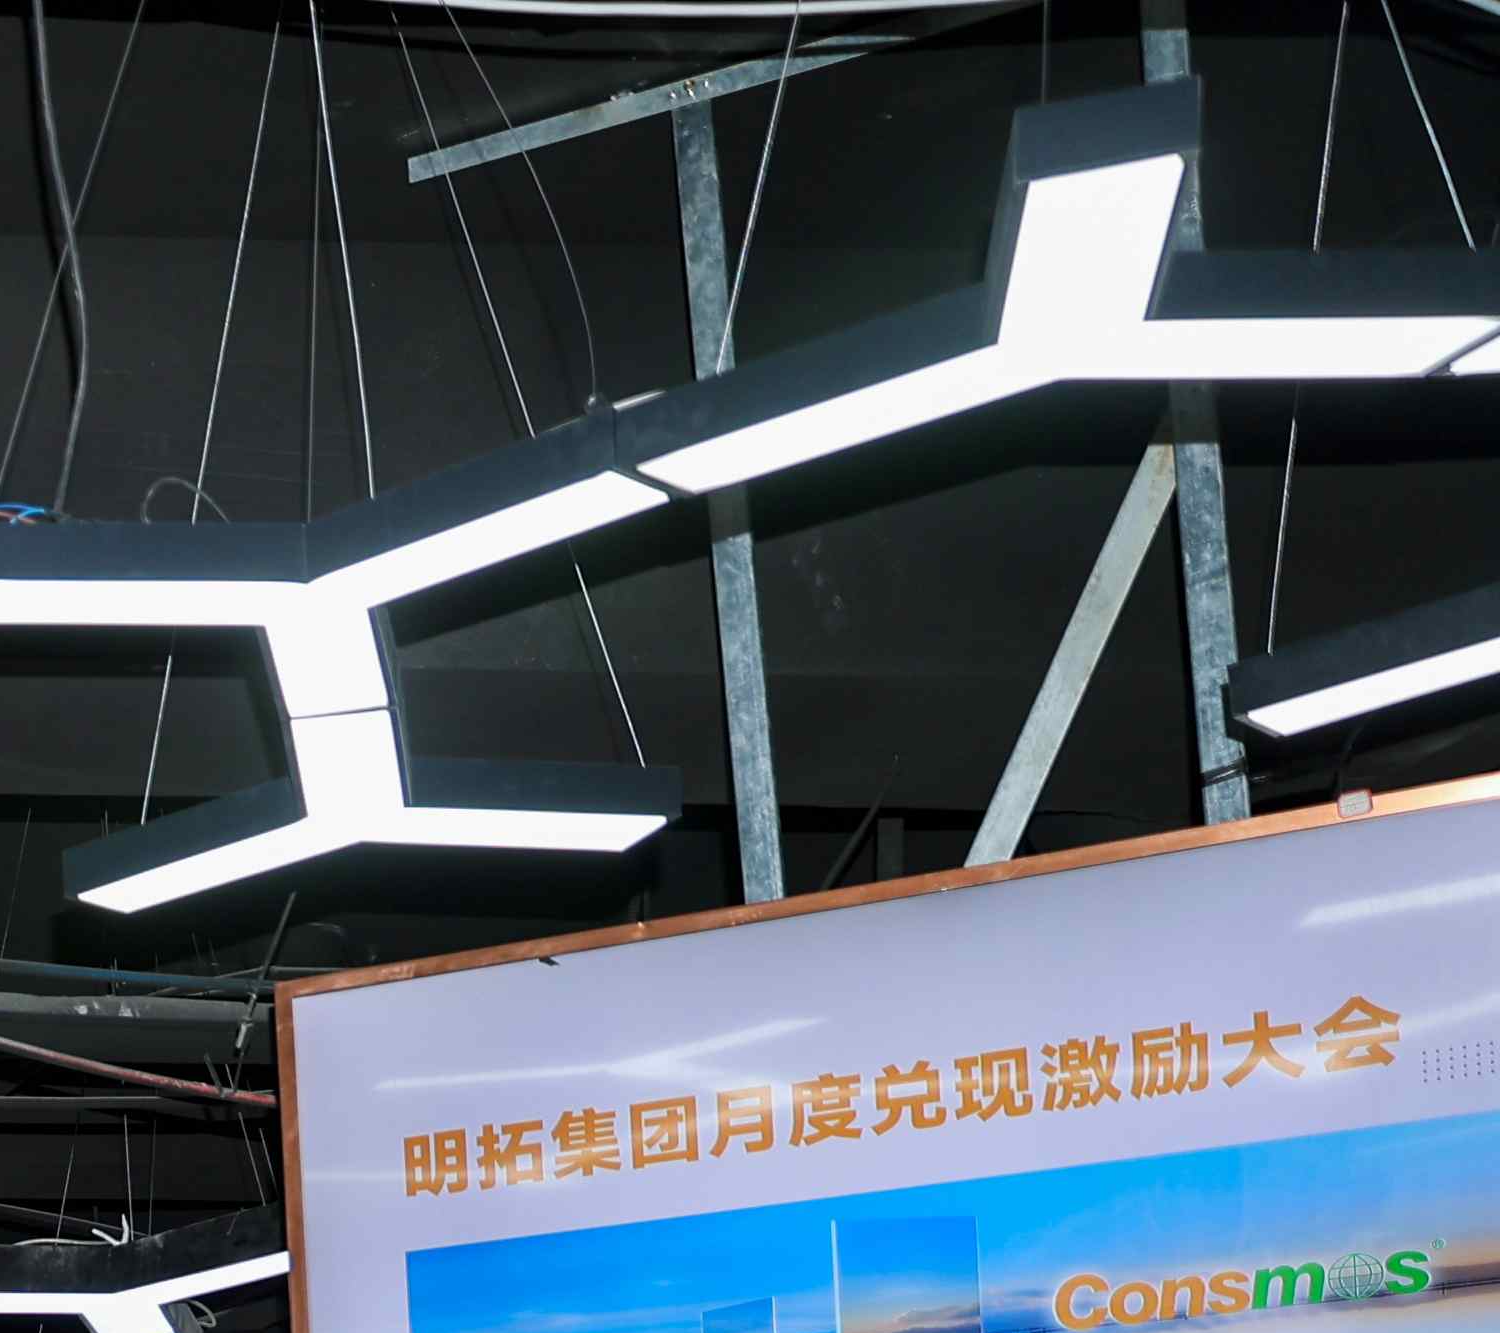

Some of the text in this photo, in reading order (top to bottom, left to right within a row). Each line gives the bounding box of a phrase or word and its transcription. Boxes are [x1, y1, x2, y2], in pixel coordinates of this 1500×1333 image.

[403, 995, 1403, 1198] 明拓集团月度兑现激励大会
